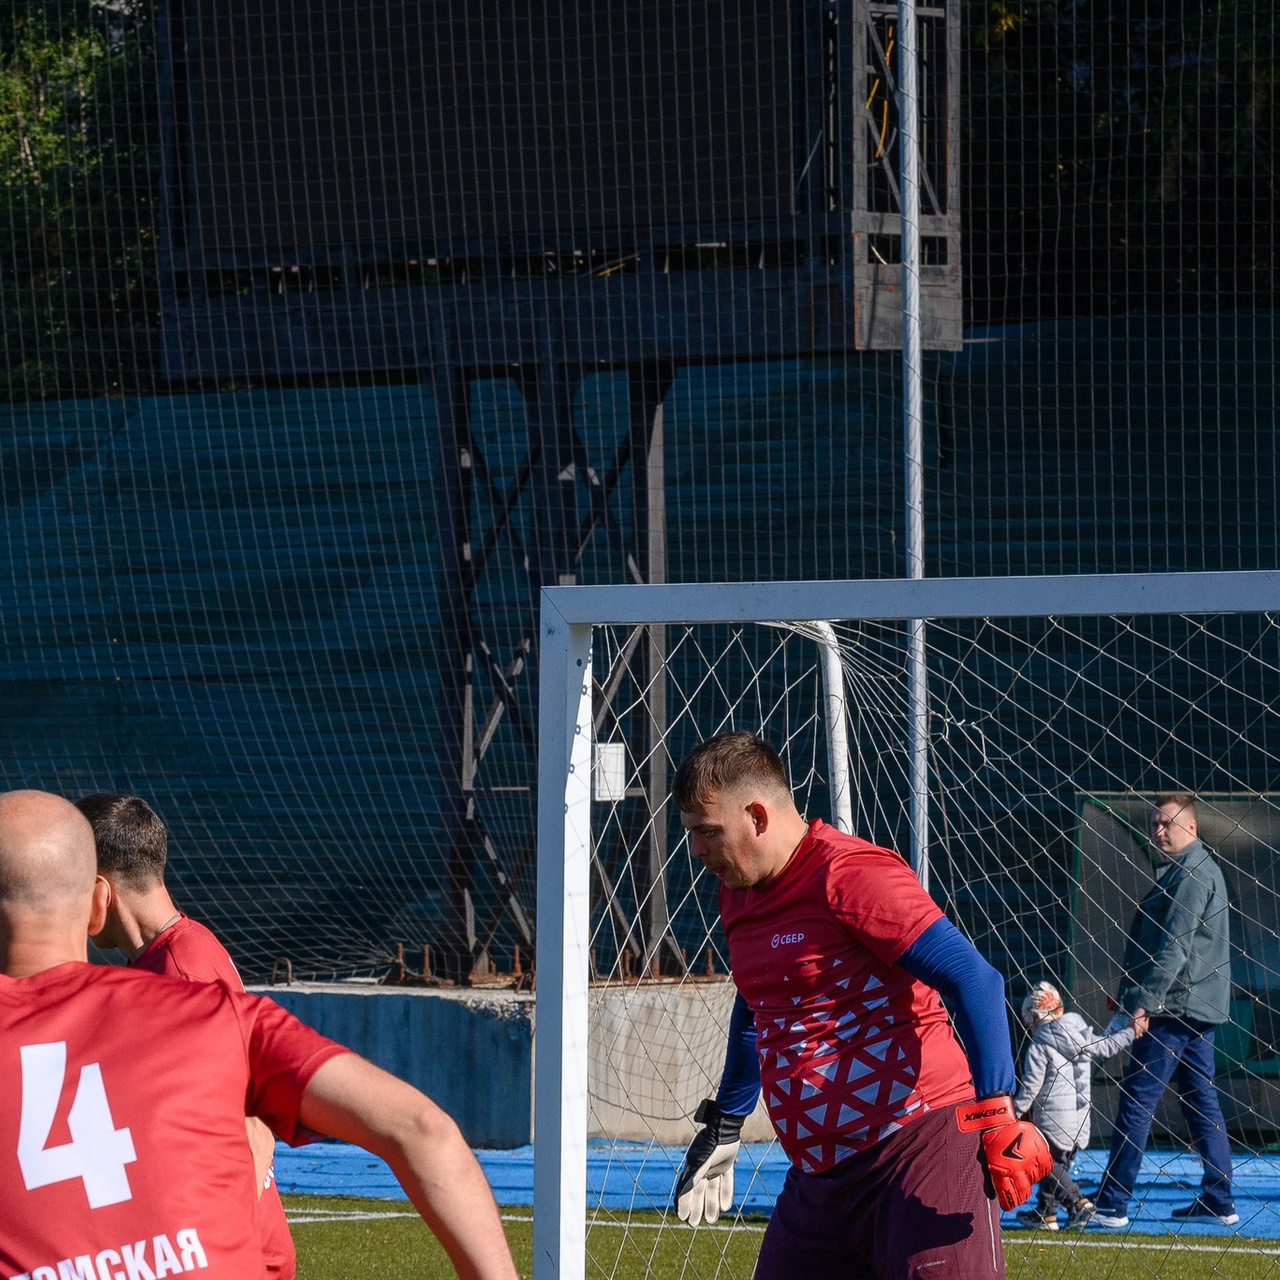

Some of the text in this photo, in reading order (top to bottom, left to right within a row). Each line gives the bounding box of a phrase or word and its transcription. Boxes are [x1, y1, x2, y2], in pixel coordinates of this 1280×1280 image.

[780, 933, 805, 945] СБЕР
[963, 1106, 1008, 1123] DEMIX
[17, 1041, 138, 1209] 4
